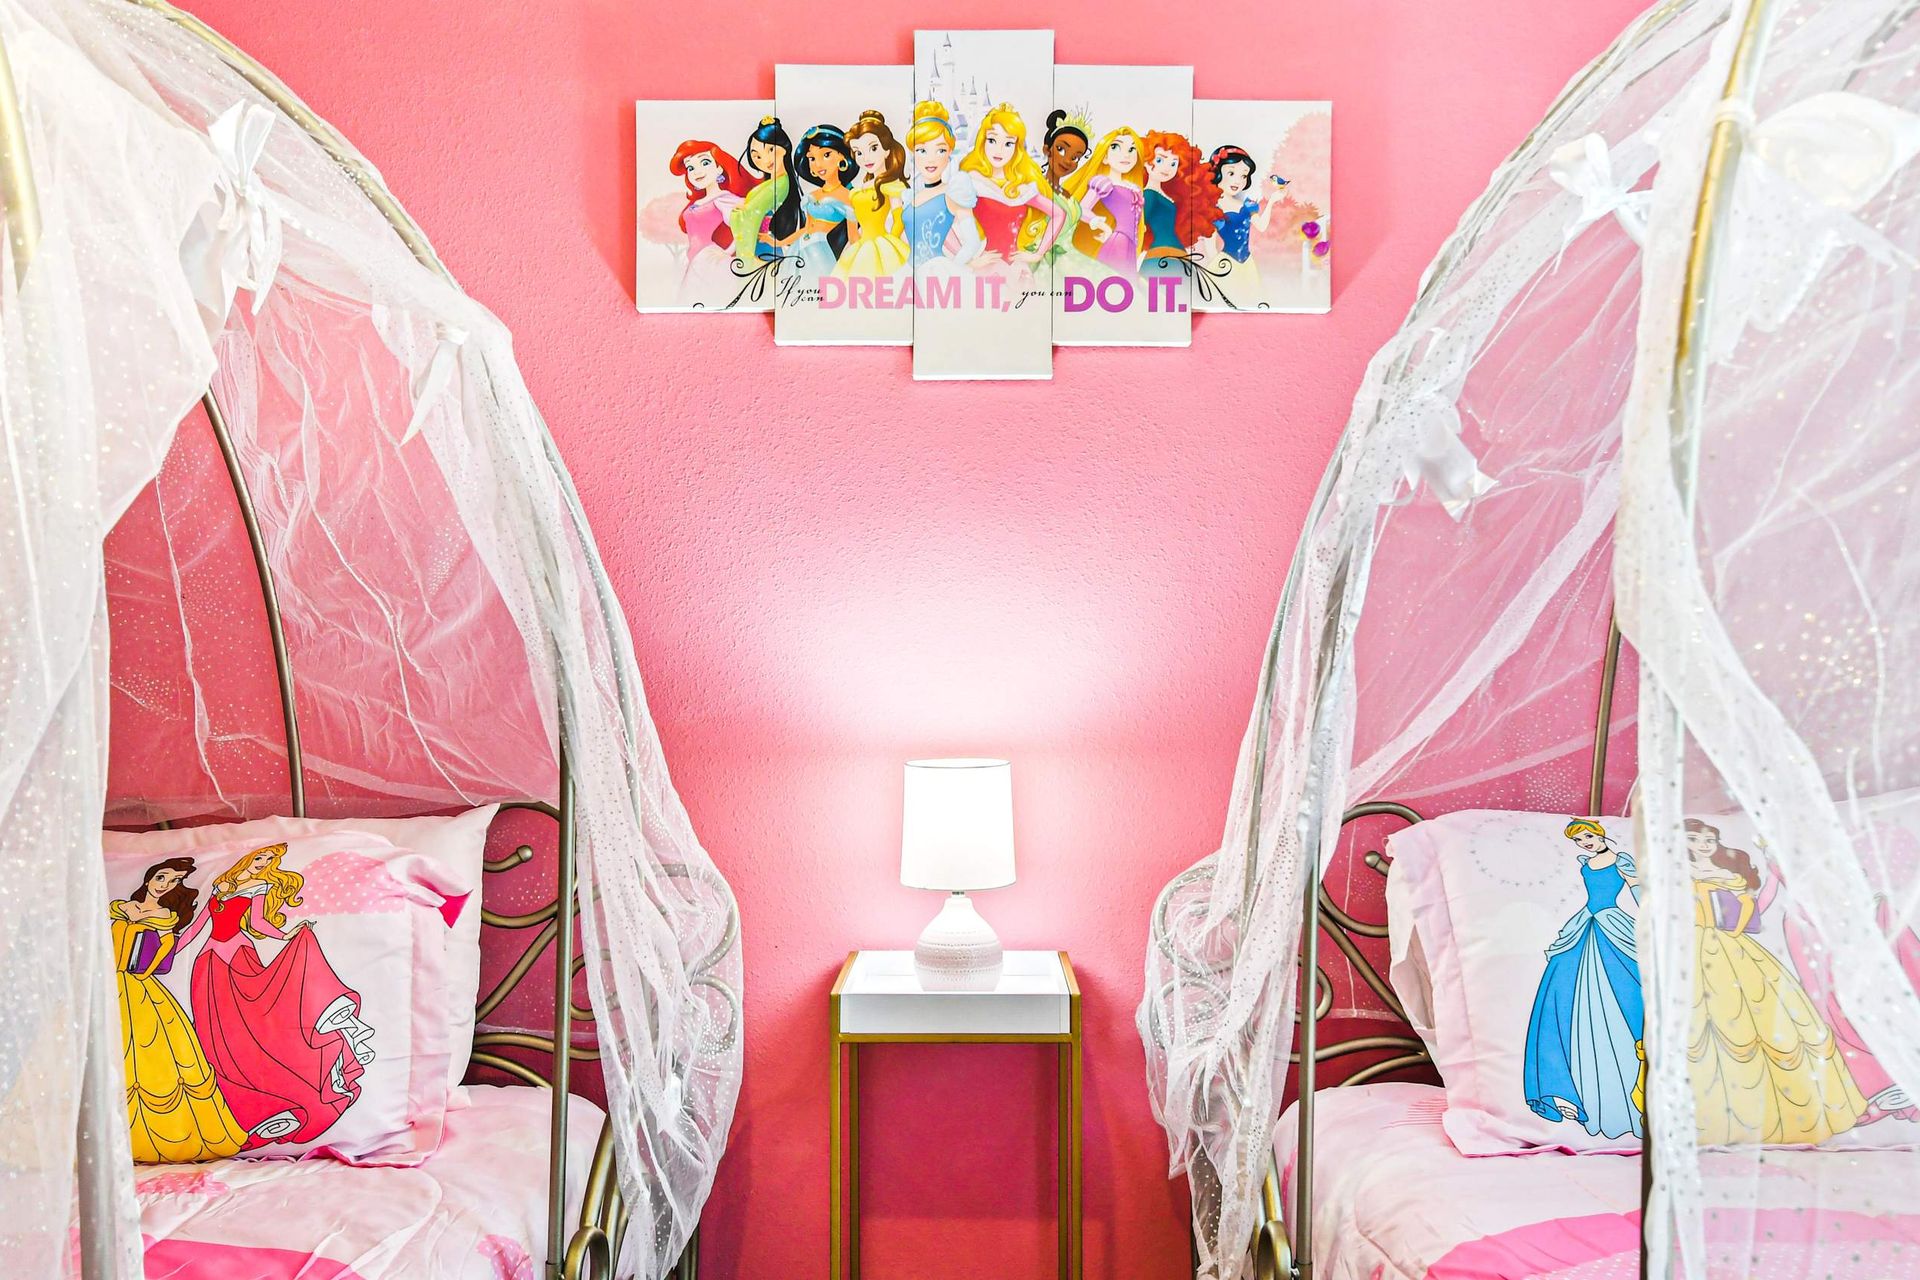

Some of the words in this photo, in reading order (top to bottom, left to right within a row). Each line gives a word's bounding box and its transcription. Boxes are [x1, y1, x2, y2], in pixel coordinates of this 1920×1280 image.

[776, 275, 801, 308] If
[791, 288, 821, 307] you
[818, 276, 961, 309] DREAM
[975, 276, 1011, 312] IT,
[1014, 289, 1045, 309] you
[1064, 276, 1134, 313] DO
[1148, 276, 1188, 313] IT.
